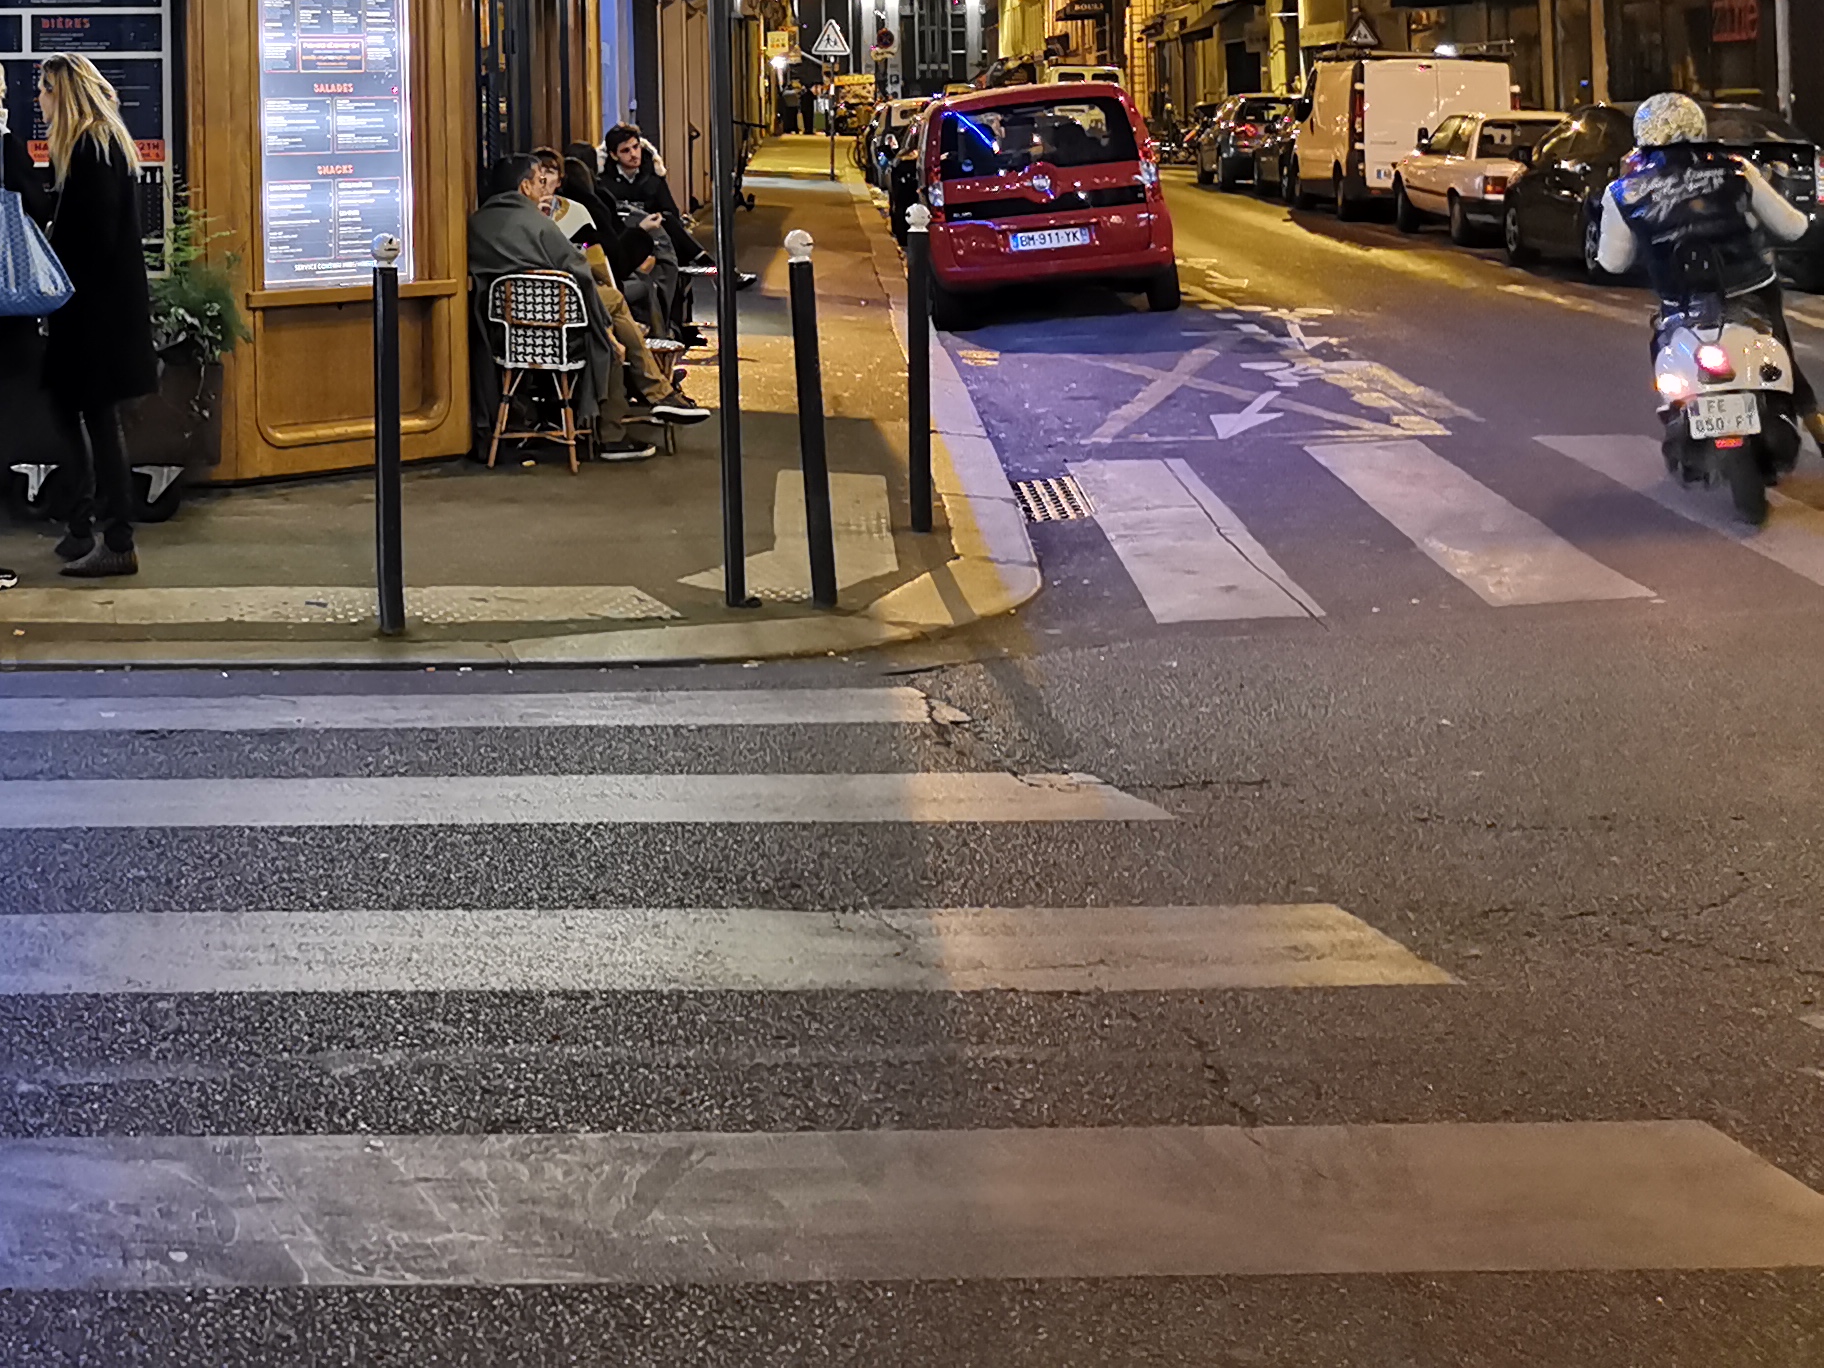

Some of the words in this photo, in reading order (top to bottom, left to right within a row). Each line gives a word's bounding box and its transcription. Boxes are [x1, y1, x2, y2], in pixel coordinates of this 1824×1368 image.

[40, 16, 91, 30] BIÈRES
[313, 83, 354, 93] SALADES
[316, 164, 354, 175] SNACKS
[1019, 230, 1081, 248] BM-911-YK
[1706, 398, 1727, 413] FE
